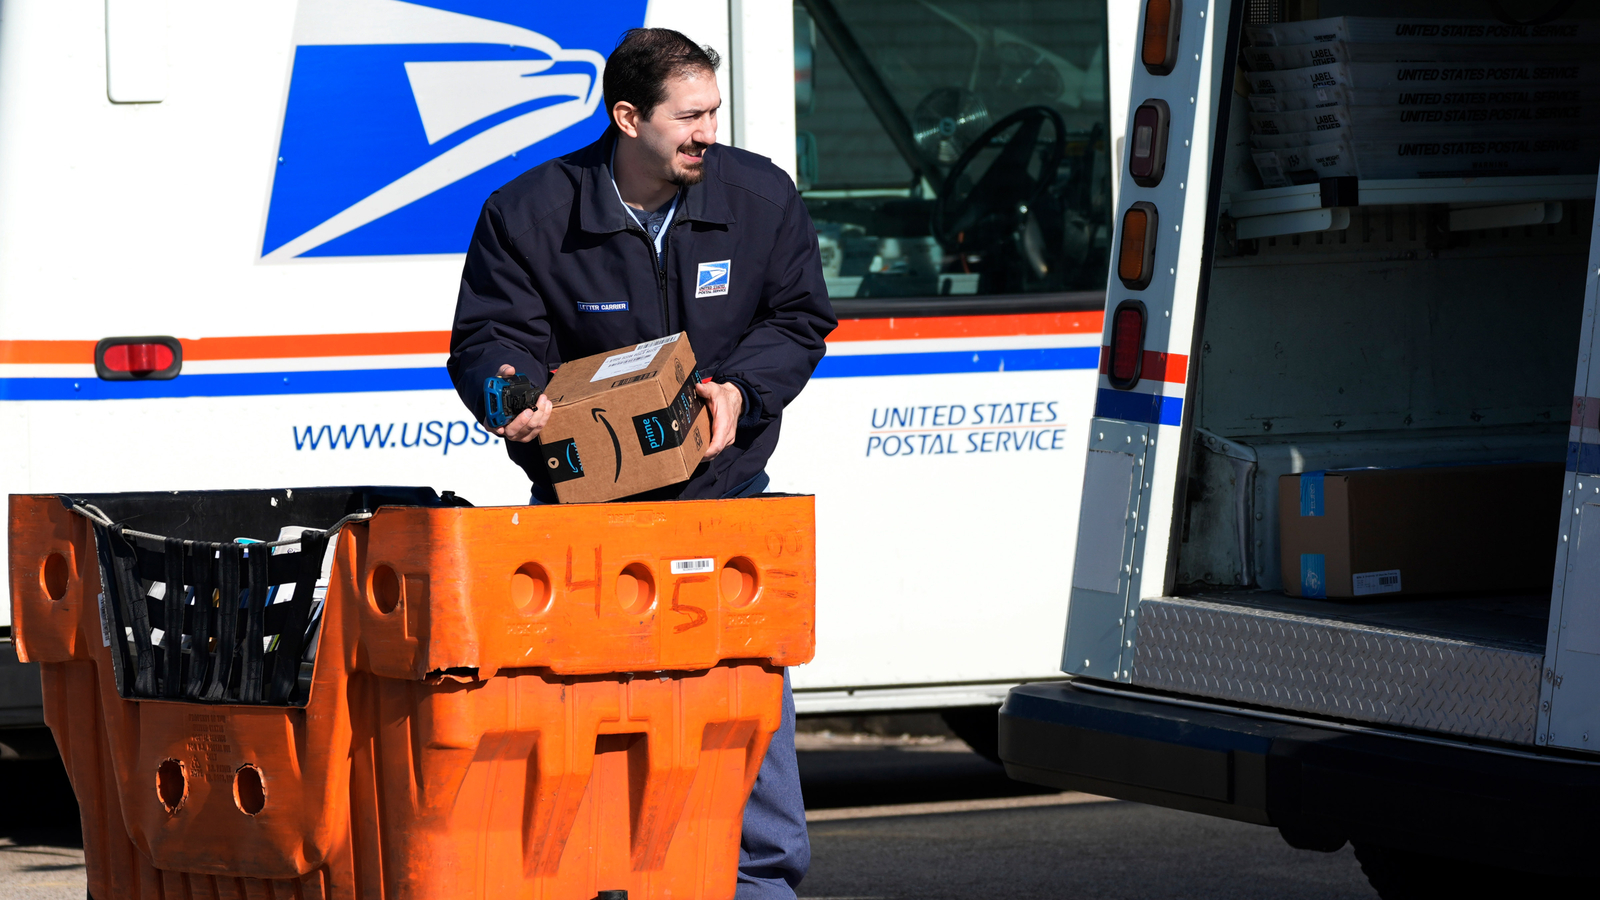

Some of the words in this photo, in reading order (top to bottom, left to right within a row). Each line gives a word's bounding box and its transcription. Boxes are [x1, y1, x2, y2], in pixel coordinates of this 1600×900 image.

[1396, 24, 1440, 36] UNITED
[1441, 24, 1486, 37] STATES
[1486, 24, 1529, 37] POSTAL
[1531, 24, 1579, 37] SERVICE
[1253, 53, 1273, 62] LABEL
[1310, 49, 1334, 59] LABEL
[1310, 72, 1334, 83] LABEL
[1397, 69, 1440, 81] UNITED
[1441, 69, 1486, 81] STATES
[1486, 68, 1530, 80] POSTAL
[1532, 67, 1580, 79] SERVICE
[1398, 93, 1441, 105] UNITED
[1443, 92, 1486, 104] STATES
[1488, 92, 1529, 103] POSTAL
[1534, 90, 1580, 102] SERVICE
[1314, 114, 1339, 125] LABEL
[1400, 110, 1443, 122] UNITED
[1444, 109, 1488, 121] STATES
[1489, 108, 1532, 120] POSTAL
[1534, 106, 1581, 119] SERVICE
[1398, 144, 1441, 156] UNITED
[1442, 142, 1486, 155] STATES
[1487, 140, 1530, 153] POSTAL
[1533, 139, 1580, 152] SERVICE
[1472, 161, 1509, 169] WARNING
[600, 303, 627, 311] CARRIER
[871, 404, 966, 429] UNITED
[971, 400, 1059, 426] STATES
[642, 418, 661, 450] prime
[866, 433, 959, 457] POSTAL
[965, 428, 1067, 454] SERVICE
[566, 544, 603, 620] 4
[669, 575, 711, 634] 5
